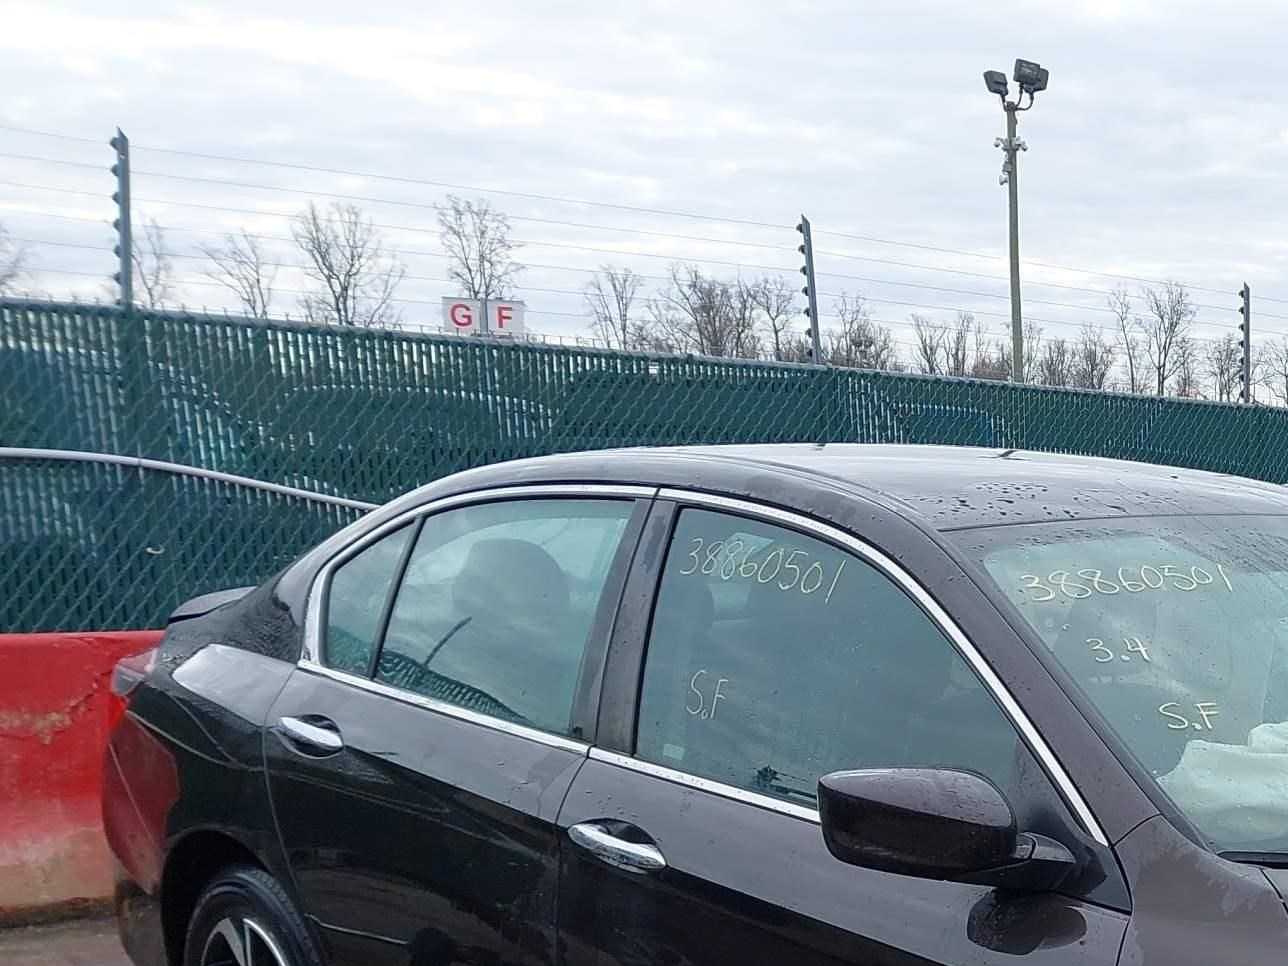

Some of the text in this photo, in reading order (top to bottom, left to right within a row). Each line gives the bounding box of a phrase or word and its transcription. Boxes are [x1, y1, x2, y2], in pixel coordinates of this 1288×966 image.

[450, 303, 473, 327] G
[497, 306, 513, 329] F
[680, 537, 847, 604] 38860501
[1020, 564, 1233, 601] 38860501
[1086, 636, 1152, 663] 3.4
[1158, 702, 1220, 730] S.F
